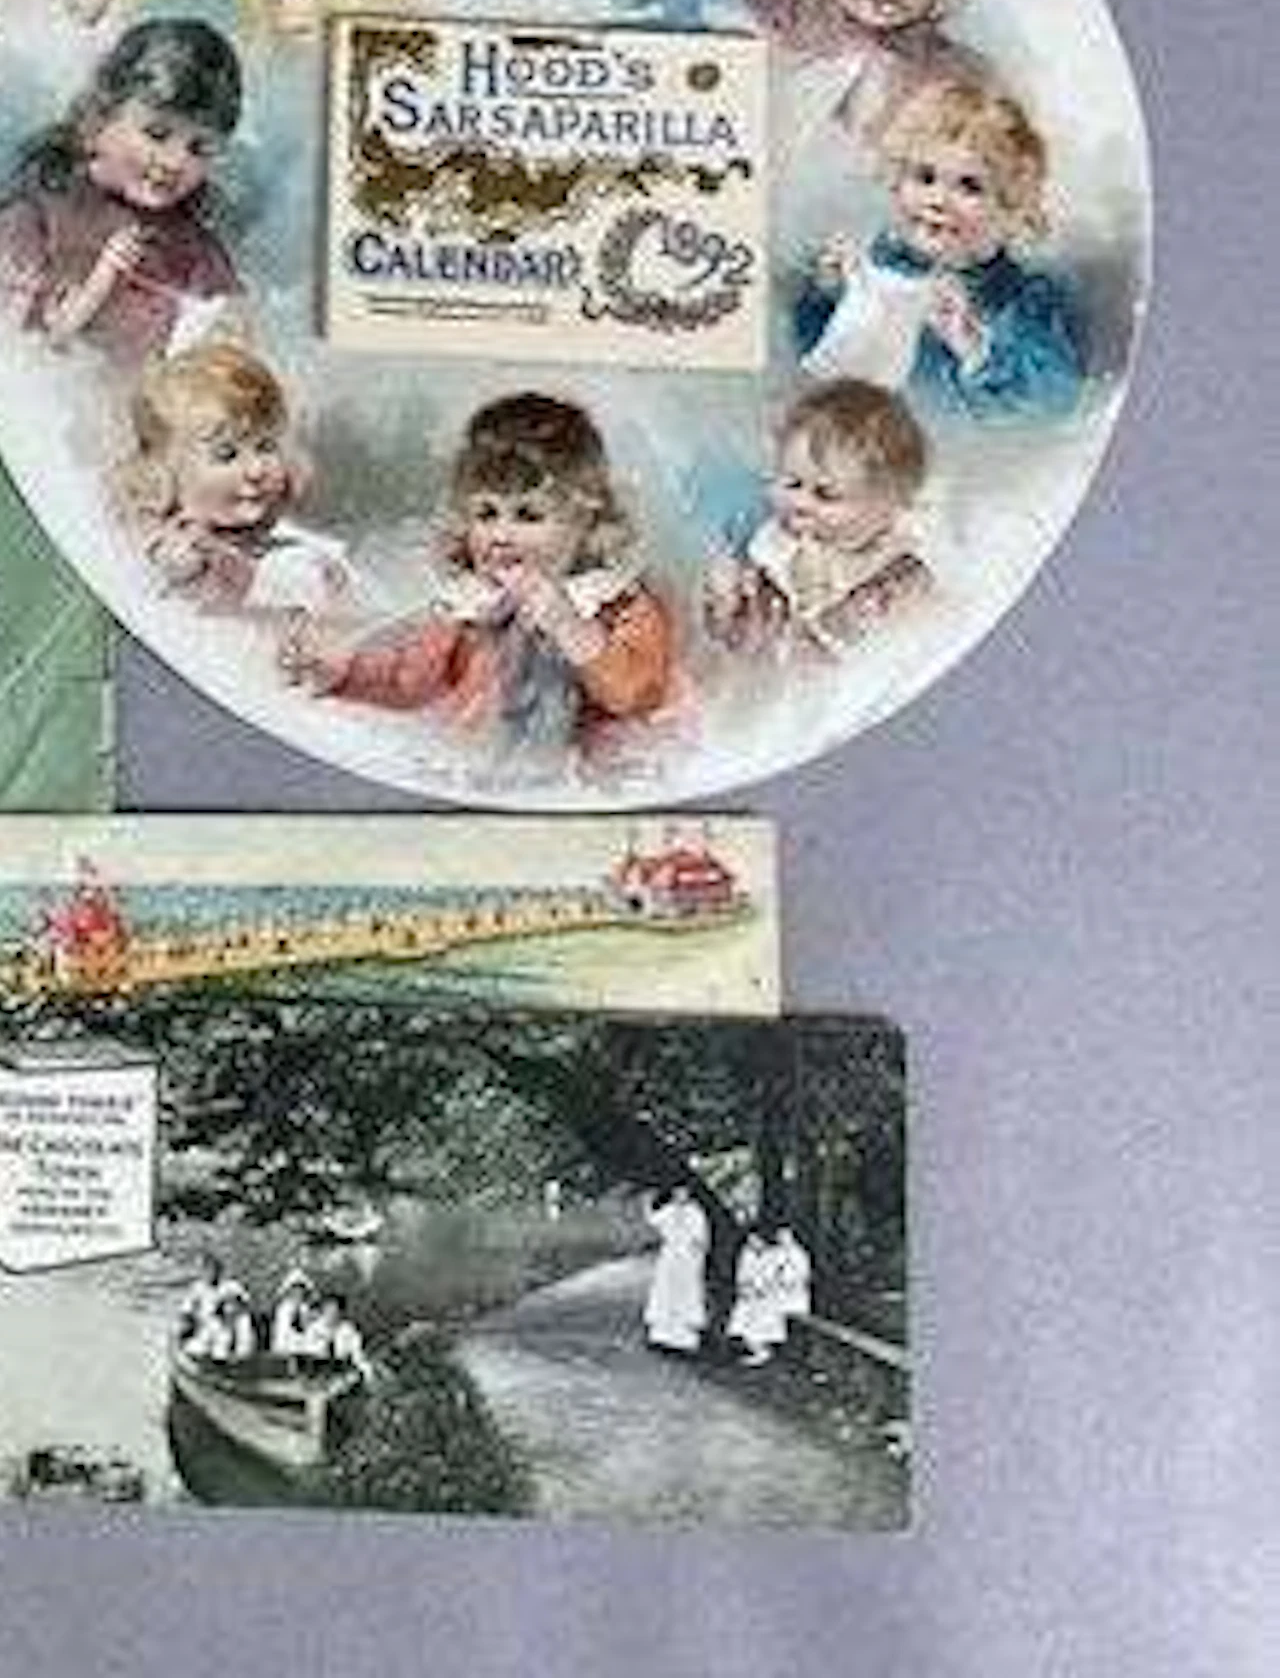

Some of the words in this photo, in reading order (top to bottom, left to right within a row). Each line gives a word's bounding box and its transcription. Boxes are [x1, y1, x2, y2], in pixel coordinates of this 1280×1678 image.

[461, 39, 655, 98] HOOD'S
[382, 77, 739, 149] SARSAPARILLA
[351, 231, 574, 288] CALENDAR
[660, 217, 755, 288] 1892
